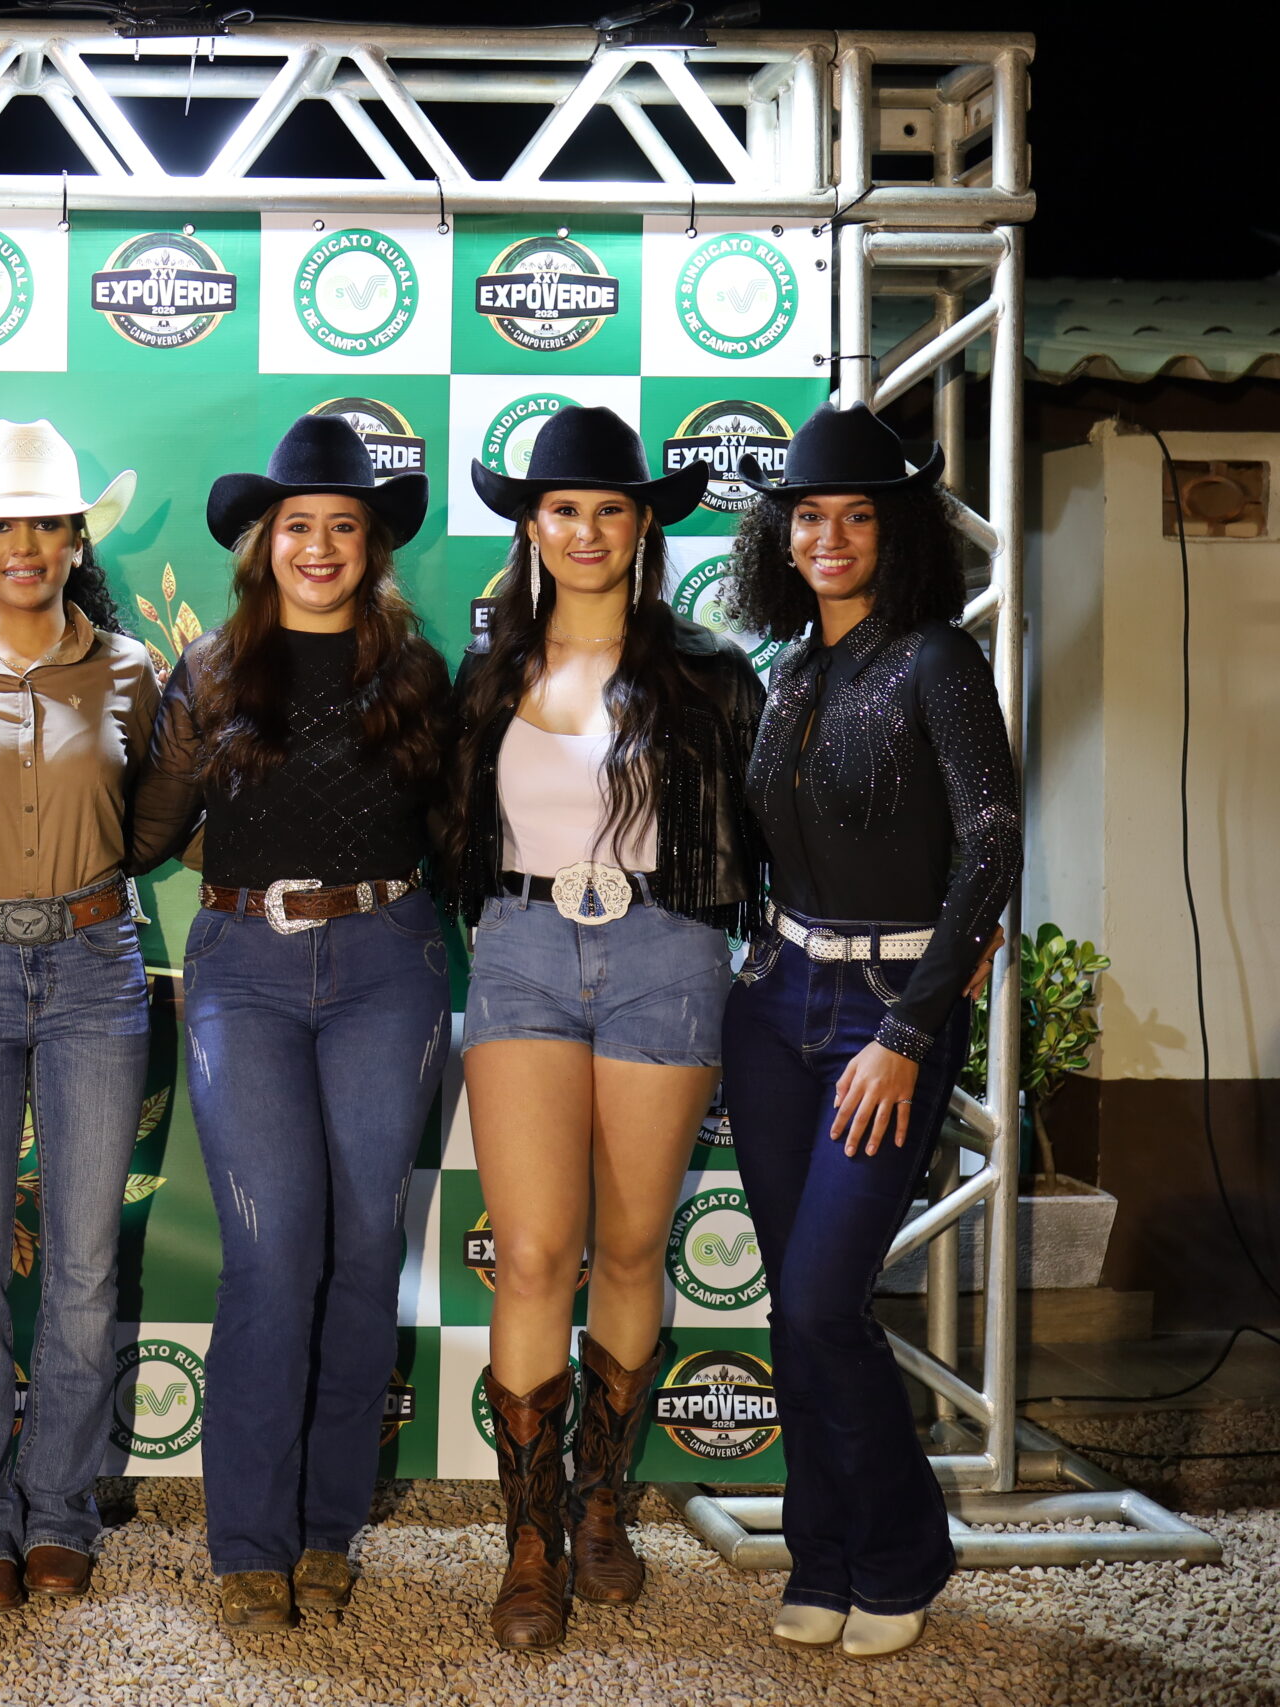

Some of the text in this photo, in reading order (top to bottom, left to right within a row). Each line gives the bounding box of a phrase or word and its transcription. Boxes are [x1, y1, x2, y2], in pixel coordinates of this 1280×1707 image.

[150, 268, 177, 280] XXV
[300, 234, 414, 292] SINDICATO RURAL
[681, 239, 794, 295] SINDICATO RURAL
[533, 272, 561, 284] XXV
[96, 280, 233, 306] EXPOVERDE
[480, 284, 615, 310] EXPOVERDE
[151, 306, 176, 315] 2026
[535, 310, 559, 318] 2026
[130, 326, 156, 345] CAMPO
[303, 308, 409, 351] DE CAMPO VERDE
[513, 329, 539, 348] CAMPO
[684, 311, 789, 354] DE CAMPO VERDE
[488, 399, 560, 454] SINDICATO
[720, 435, 748, 446] XXV
[722, 472, 740, 480] 202
[677, 562, 727, 615] SINDICA
[669, 1193, 741, 1248] SINDICATO
[673, 1264, 767, 1305] DE CAMPO VER
[116, 1345, 170, 1373] DICATO
[709, 1385, 735, 1395] XXV
[657, 1394, 779, 1420] EXPOVERD
[118, 1431, 166, 1454] CAMPO
[689, 1439, 715, 1456] CAMPO
